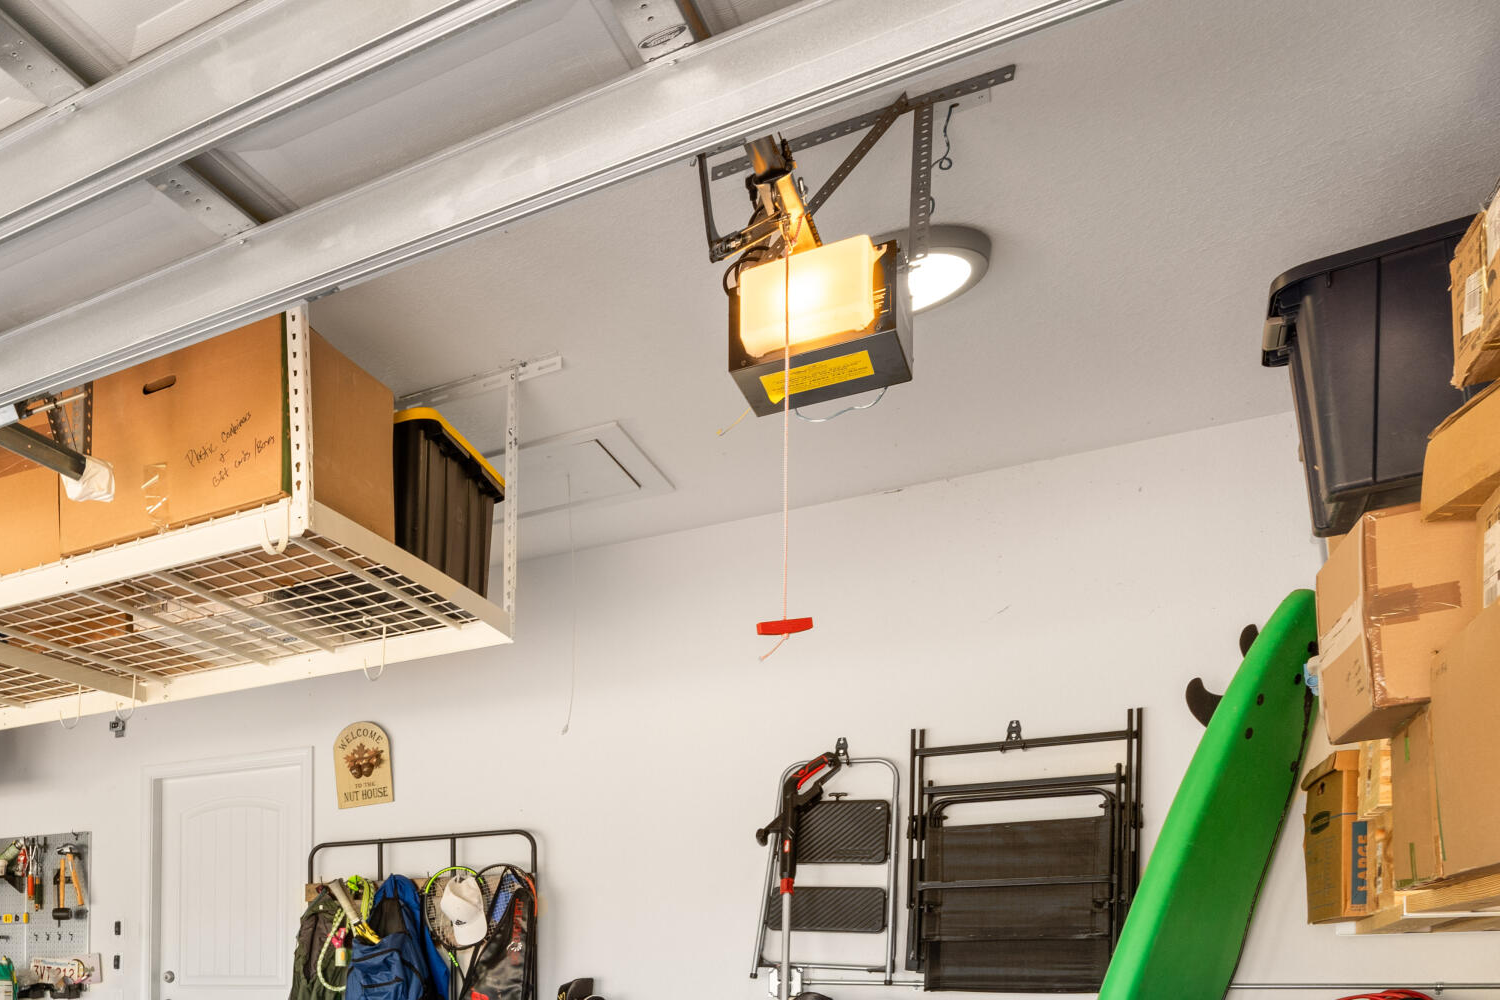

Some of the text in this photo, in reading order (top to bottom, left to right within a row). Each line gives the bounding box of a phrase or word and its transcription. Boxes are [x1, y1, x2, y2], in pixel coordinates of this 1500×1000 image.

[338, 728, 384, 751] WELCOME
[344, 786, 388, 803] NUT HOUSE
